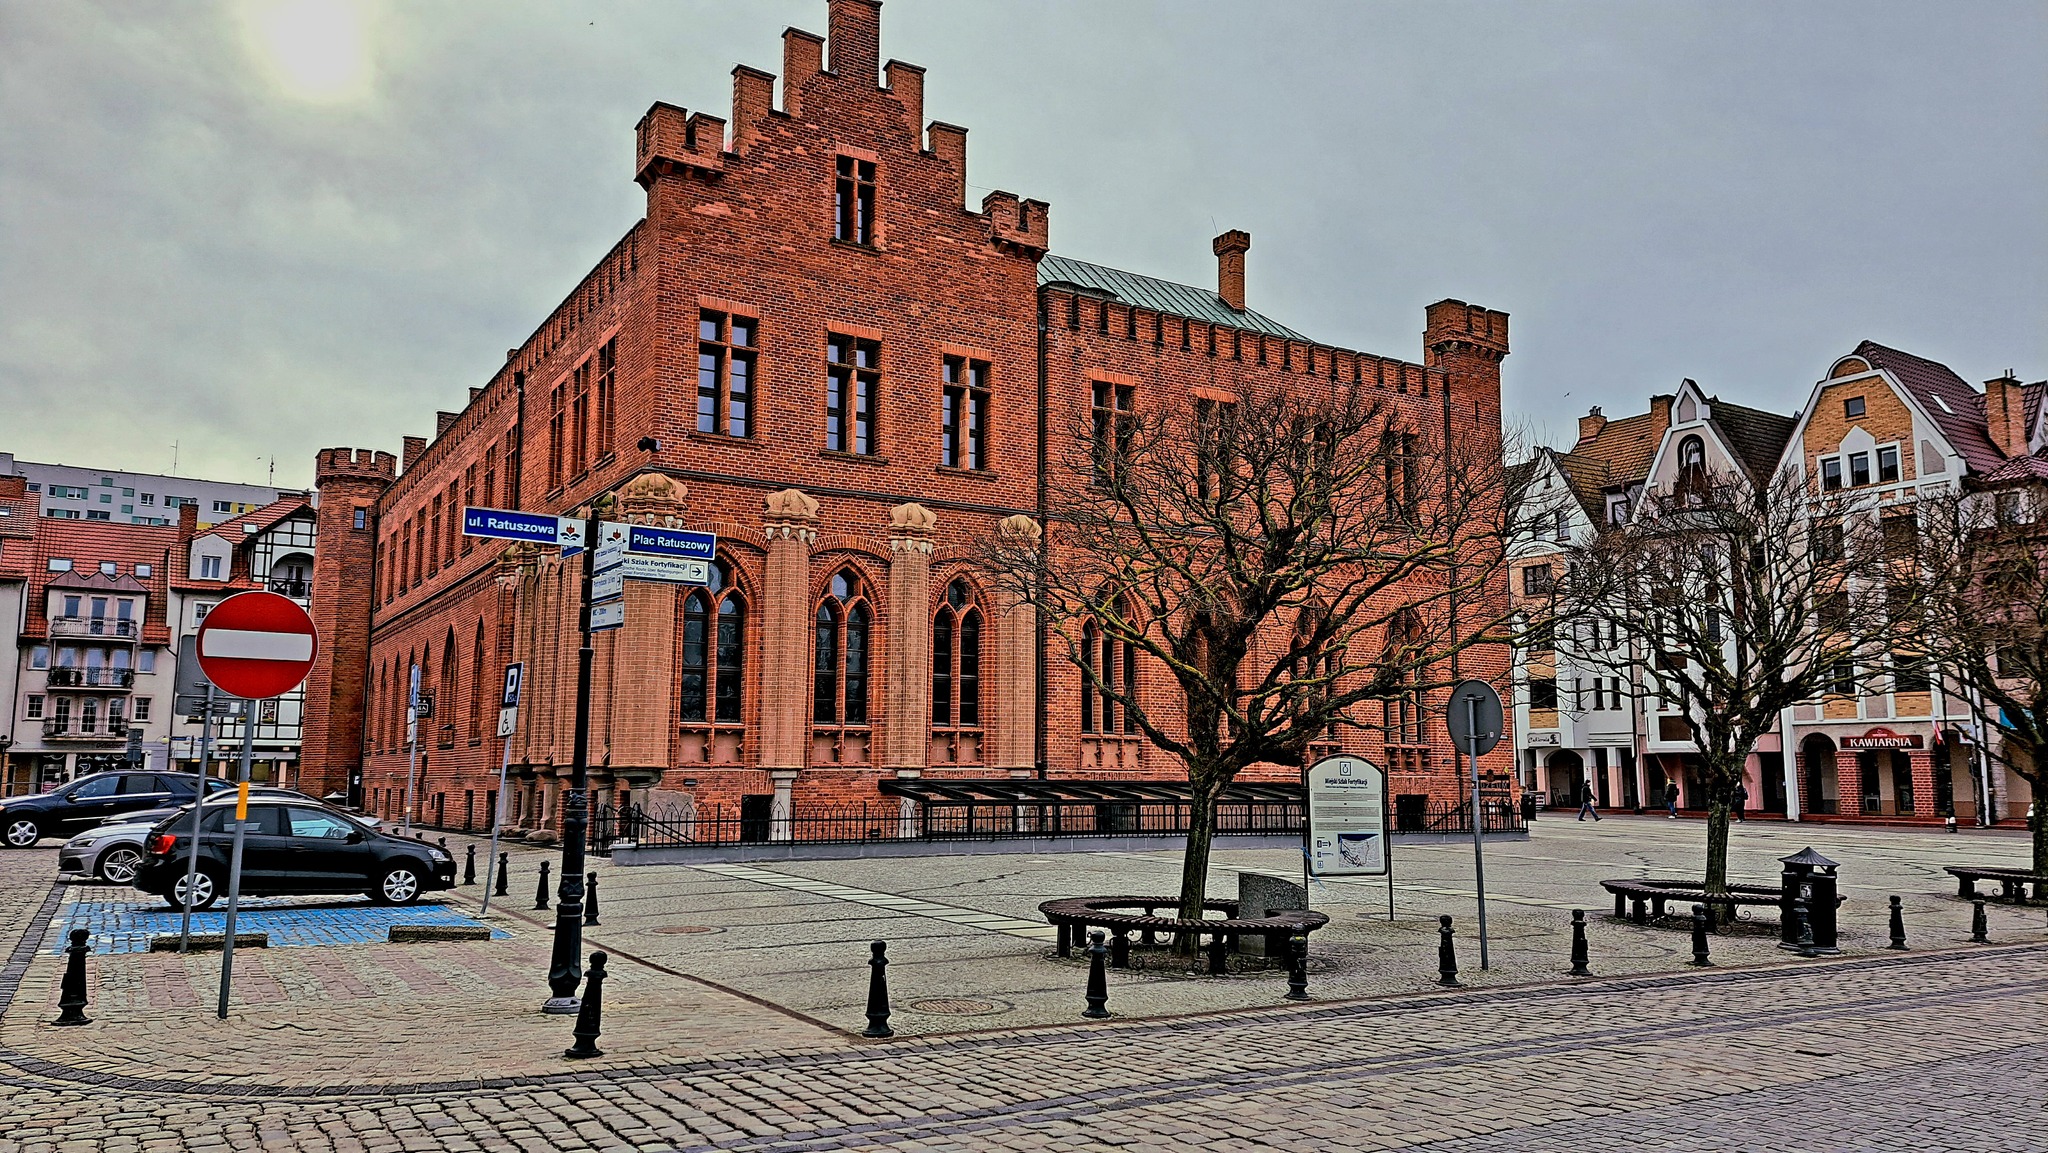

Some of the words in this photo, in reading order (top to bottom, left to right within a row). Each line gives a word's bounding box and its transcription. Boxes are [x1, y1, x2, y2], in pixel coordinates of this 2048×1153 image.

[468, 516, 484, 528] ul.
[487, 517, 555, 535] Ratuszowa
[633, 534, 655, 545] Plac
[657, 536, 711, 553] Ratuszowy
[650, 560, 688, 571] Fortyfikacji
[504, 667, 518, 703] P
[1850, 737, 1913, 747] KAWIARNIA
